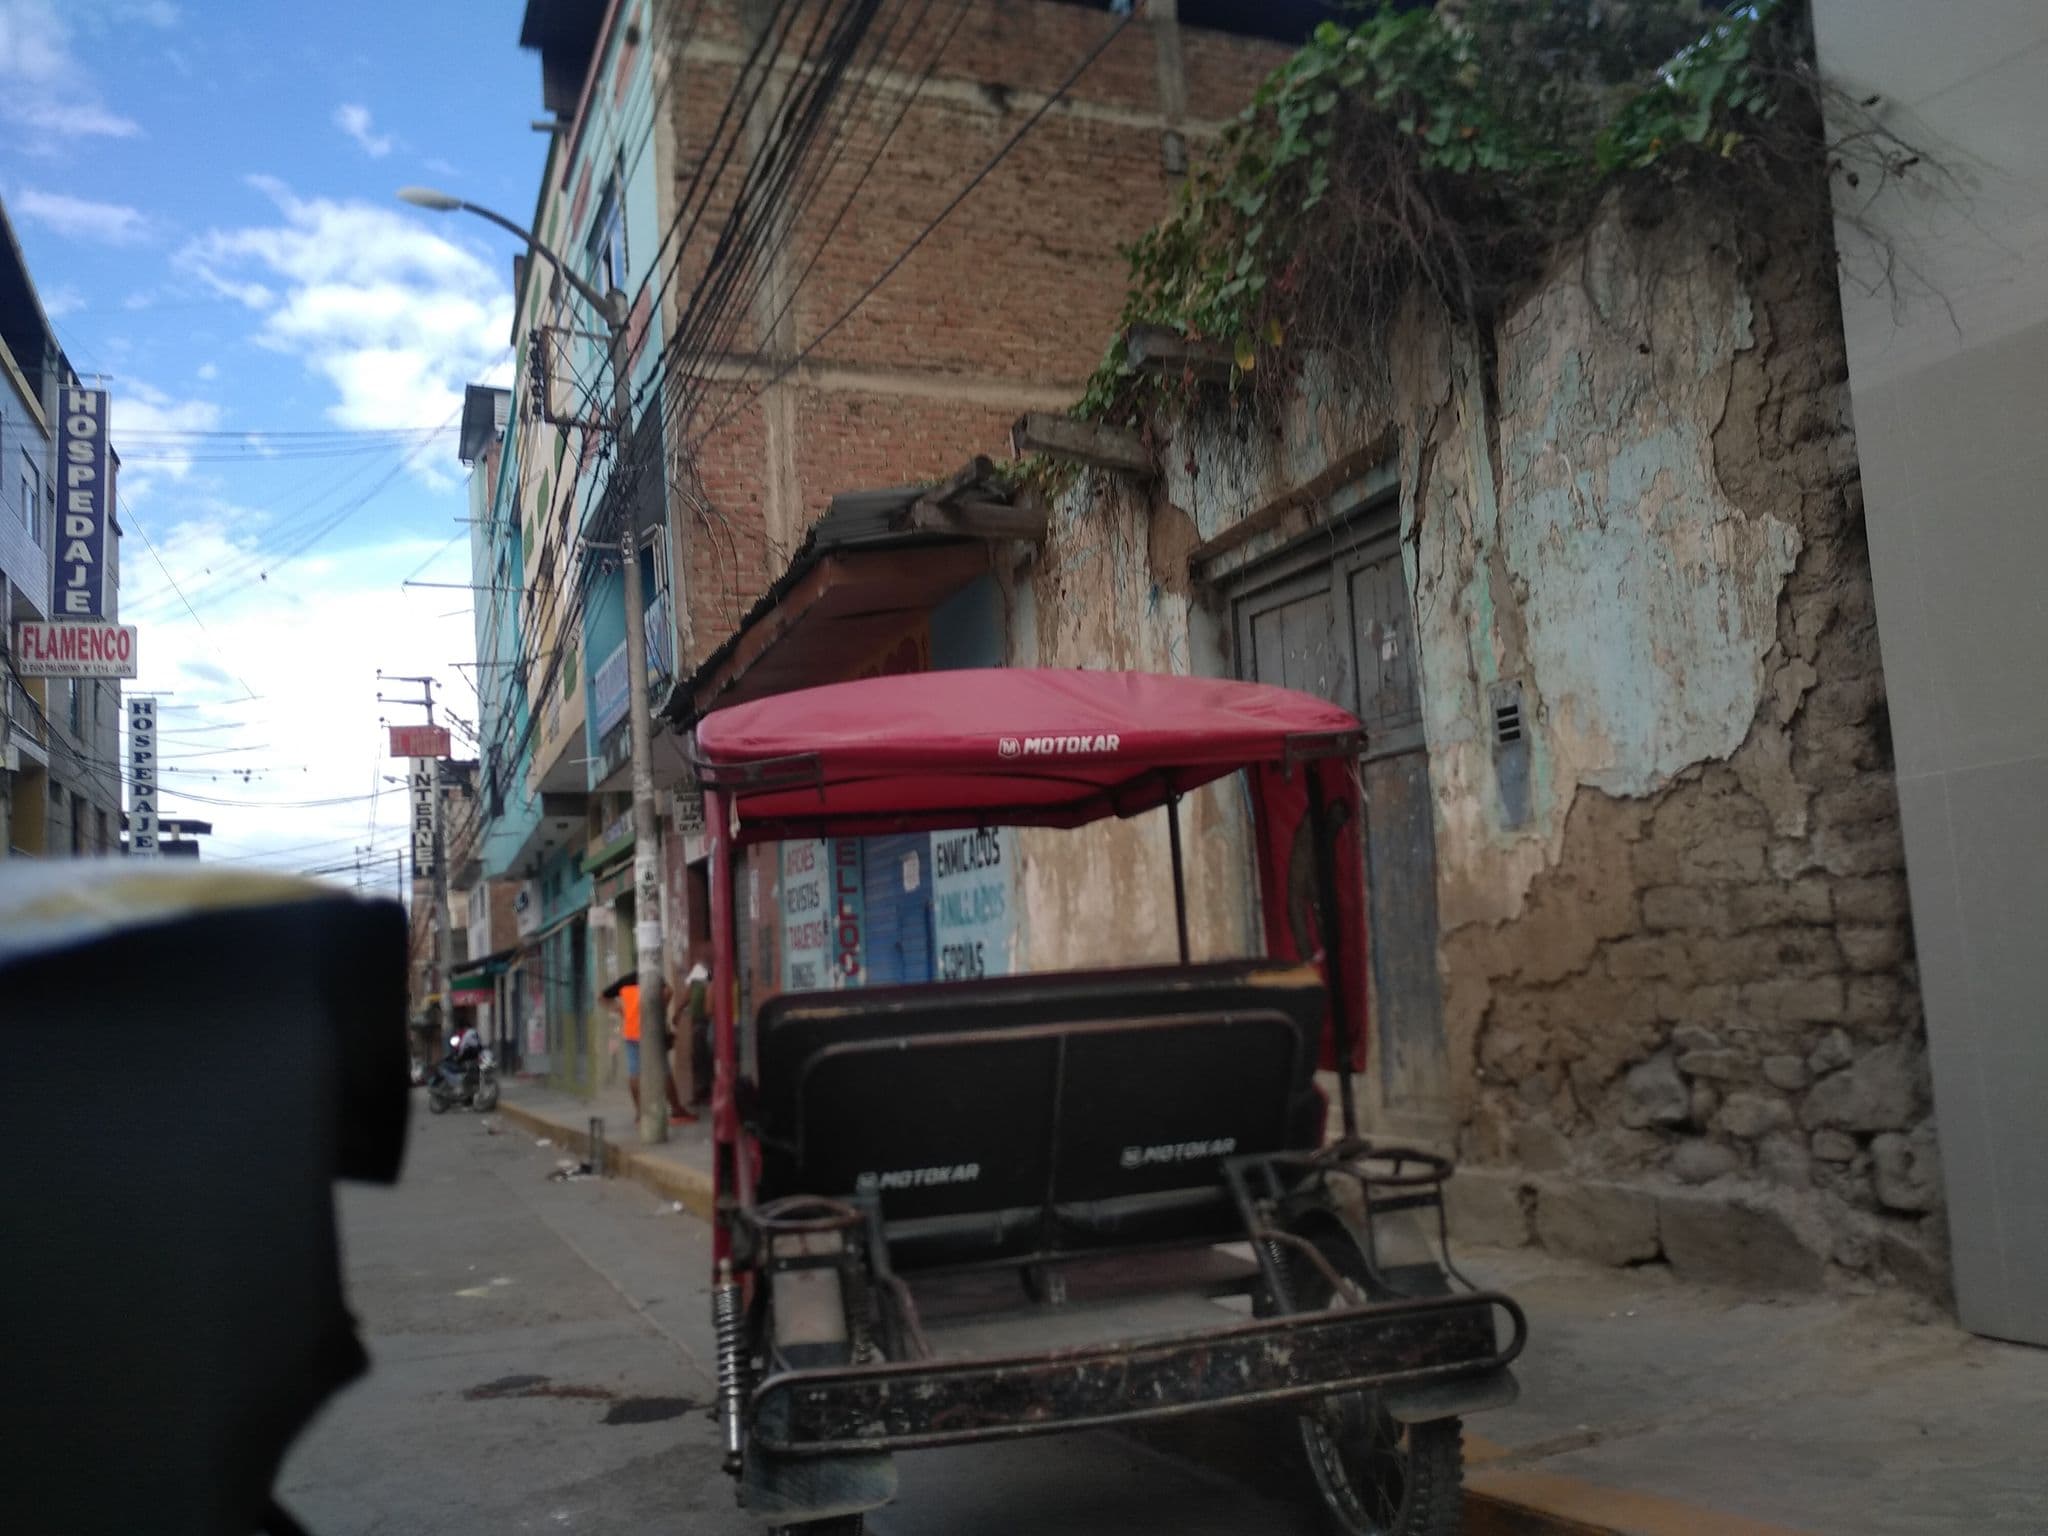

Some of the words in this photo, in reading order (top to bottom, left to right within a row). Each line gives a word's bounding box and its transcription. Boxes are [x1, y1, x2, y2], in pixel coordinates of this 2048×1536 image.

[64, 391, 98, 613] HOSPEDAJE
[23, 626, 131, 661] FLAMENCO
[1023, 734, 1120, 755] MOTOKAR
[132, 703, 154, 848] HOSPEDAJE
[415, 759, 433, 877] INTERNET
[1143, 1137, 1237, 1163] MOTOKAR
[880, 1163, 980, 1190] MOTOKAR
